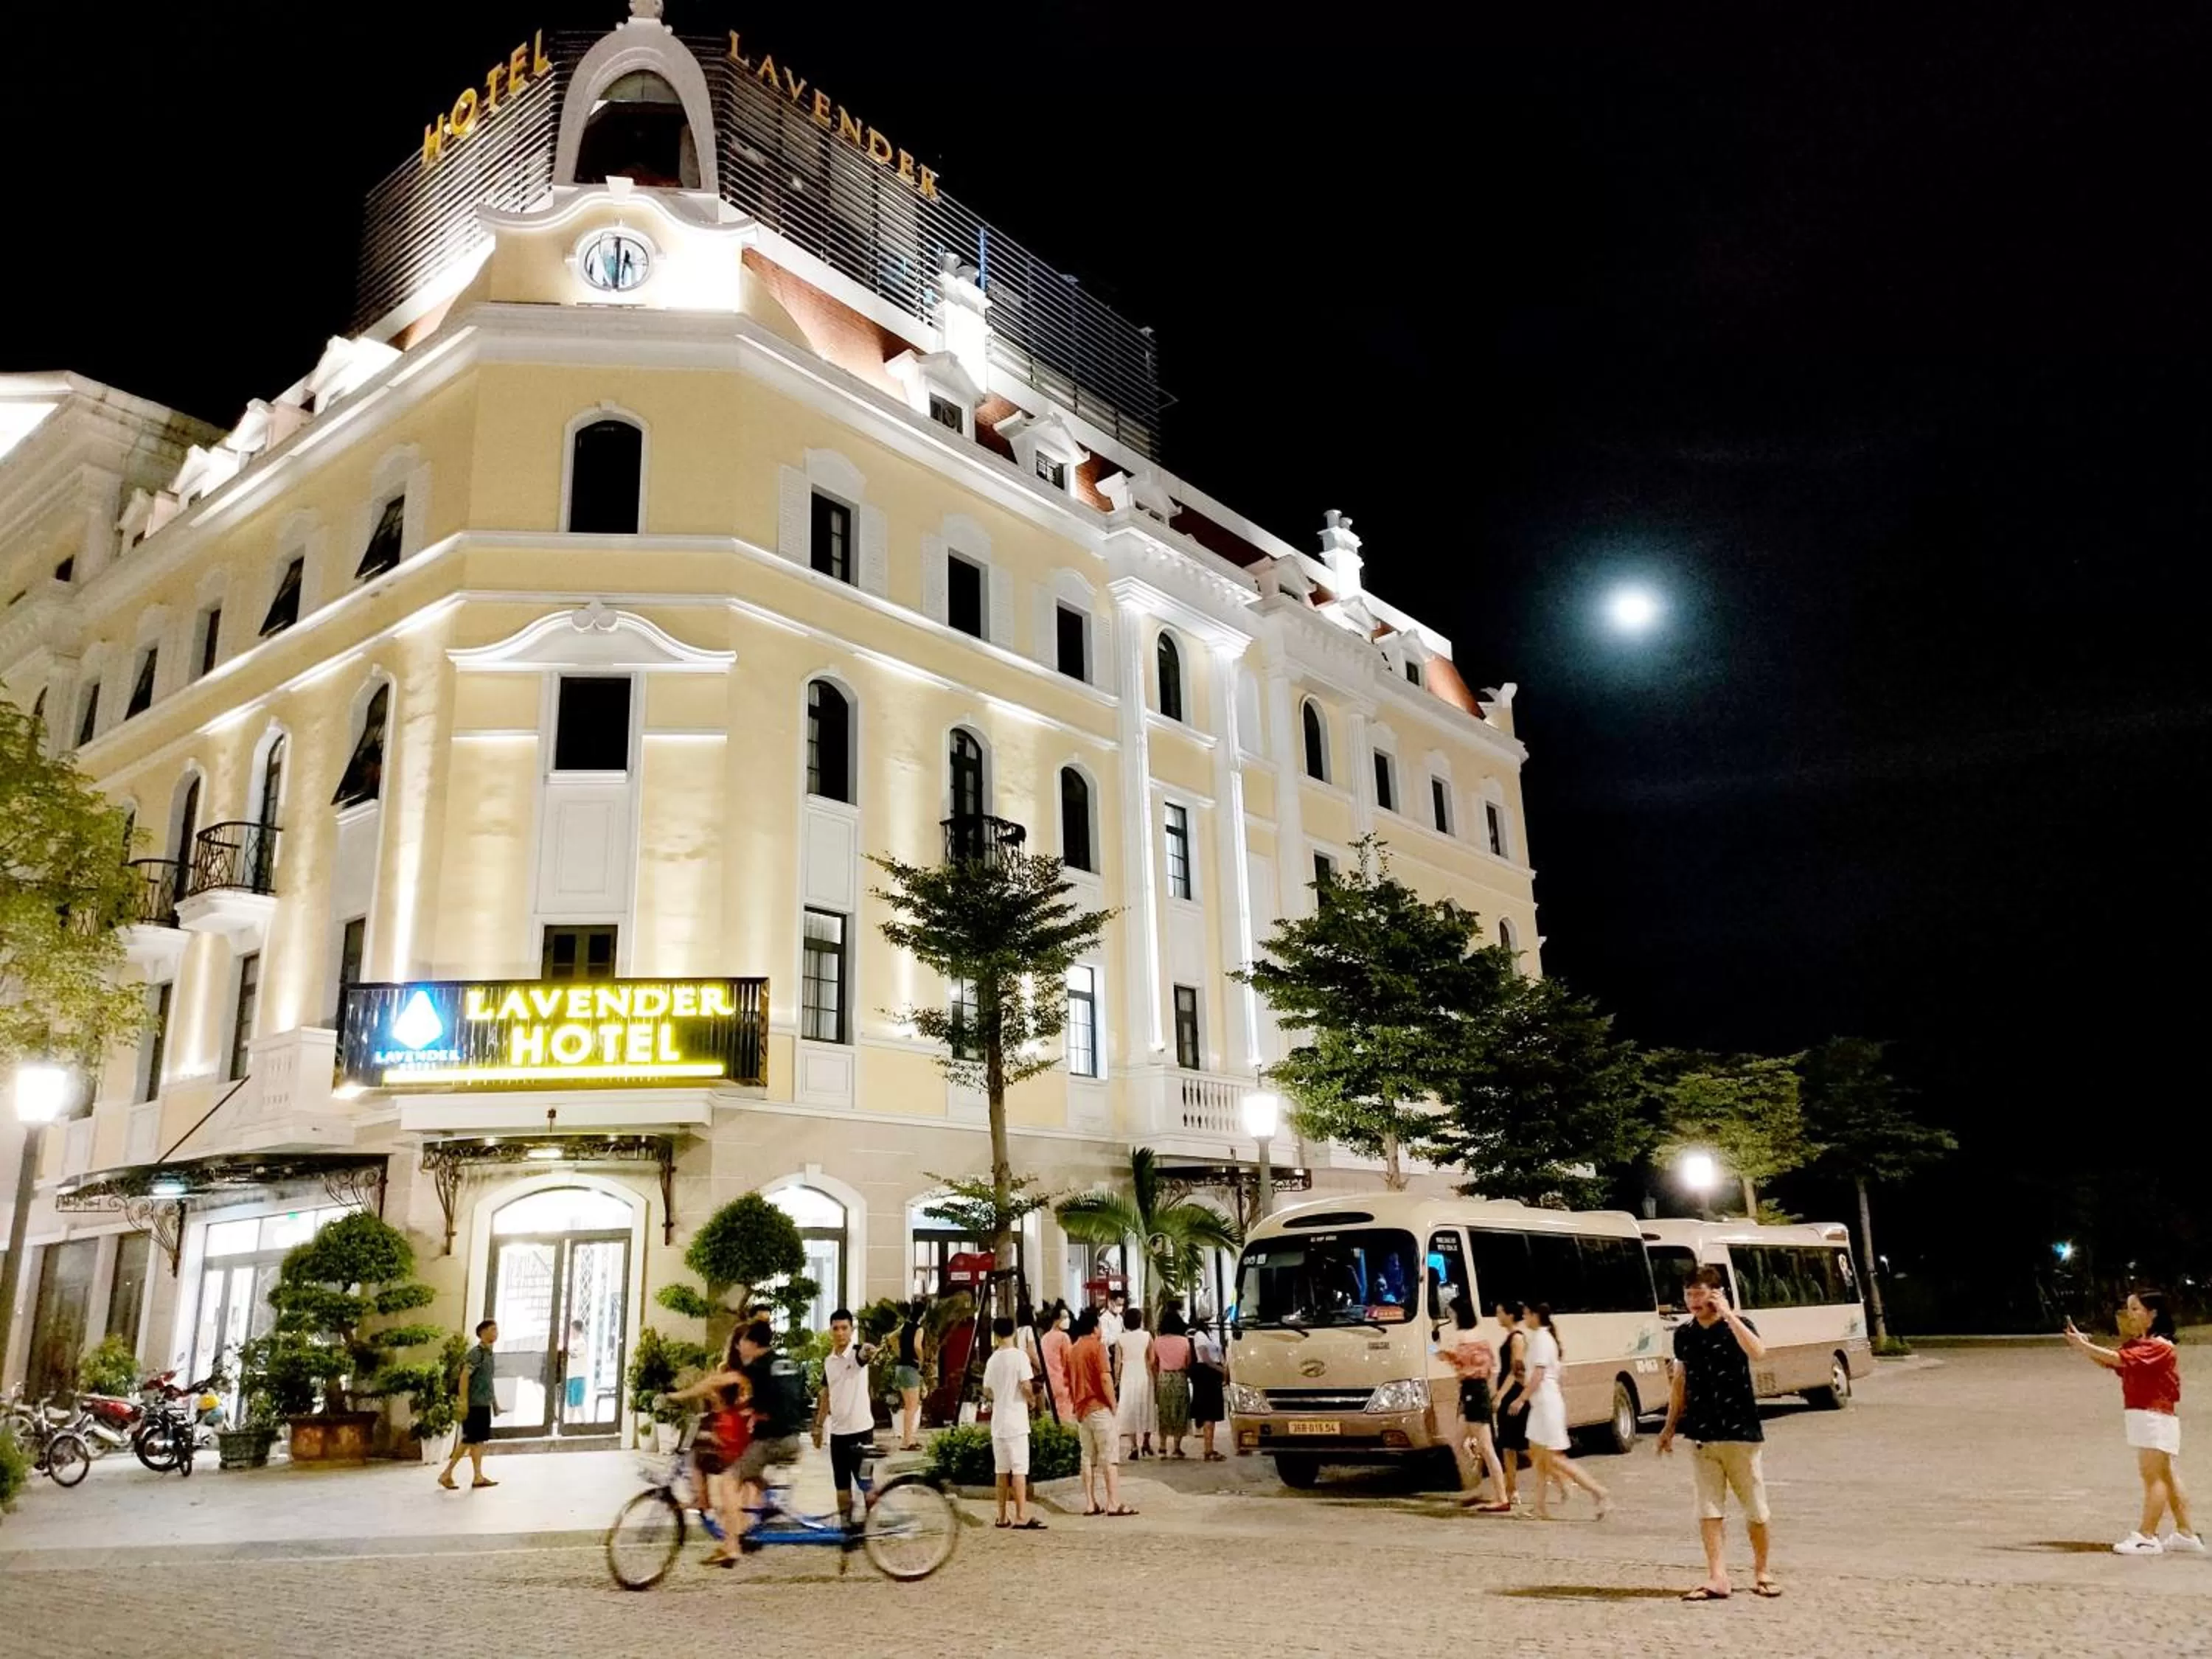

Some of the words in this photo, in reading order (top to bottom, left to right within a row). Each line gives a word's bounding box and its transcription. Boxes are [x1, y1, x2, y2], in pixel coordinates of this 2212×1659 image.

[422, 28, 553, 166] HOTEL
[728, 29, 940, 201] LAVENDER
[466, 985, 735, 1019] LAVENDER
[511, 1023, 681, 1065] HOTEL
